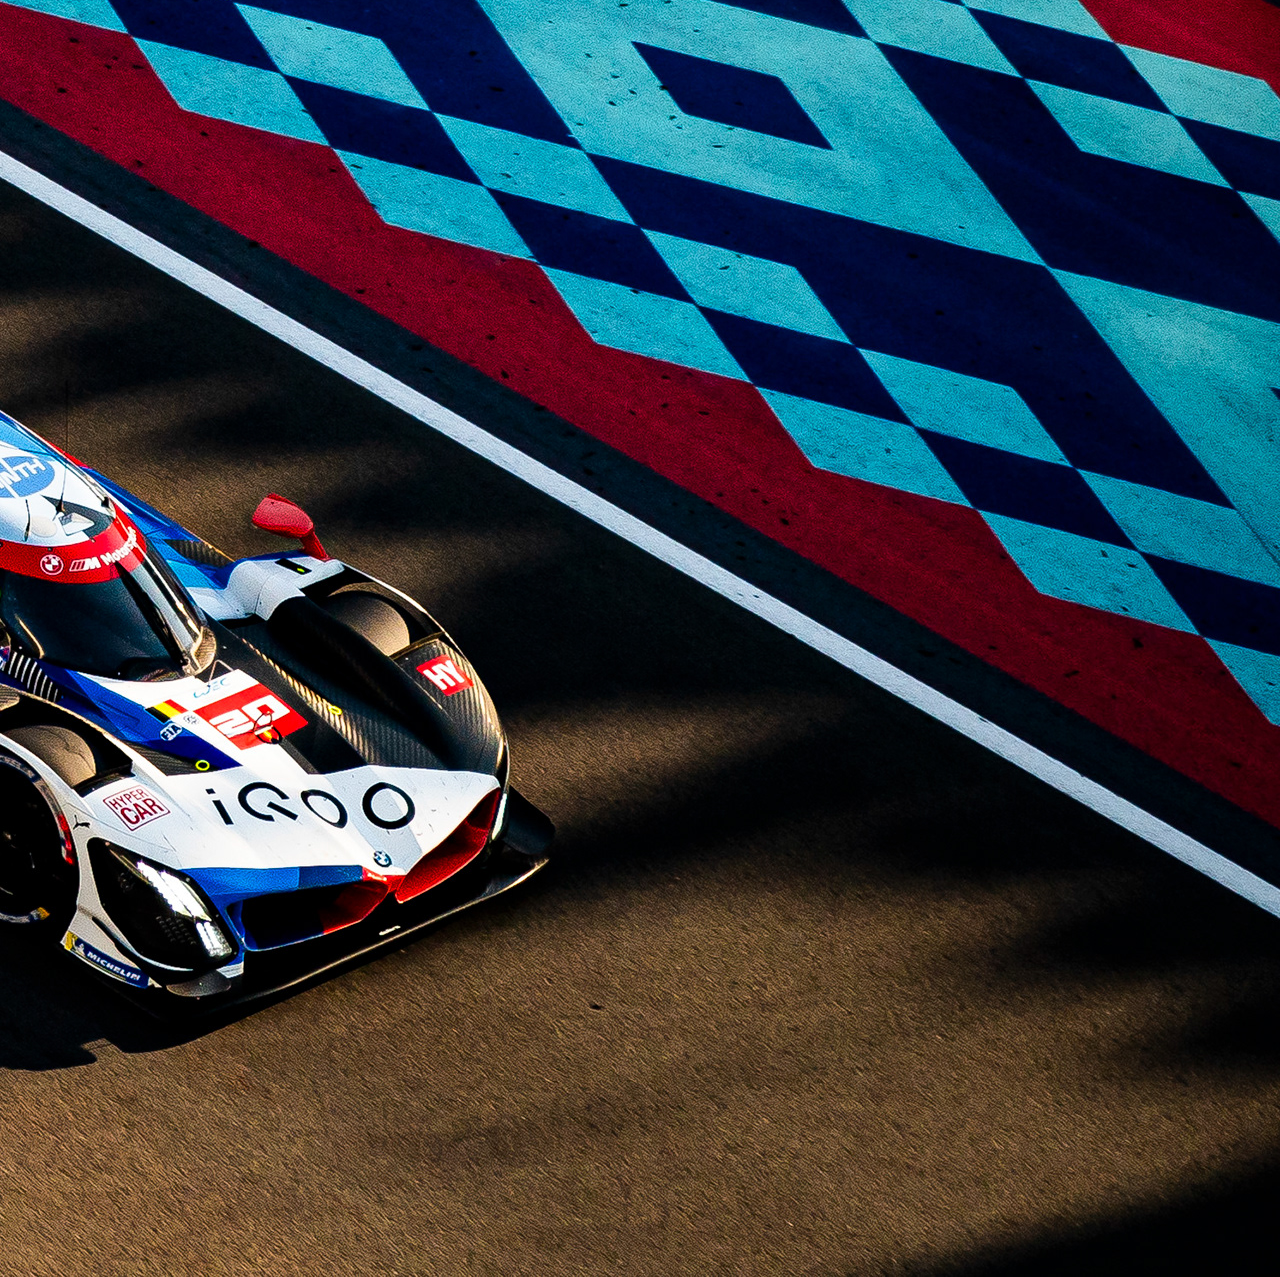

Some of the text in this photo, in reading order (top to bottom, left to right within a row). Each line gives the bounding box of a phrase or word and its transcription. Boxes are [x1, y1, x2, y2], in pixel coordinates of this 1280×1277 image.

[423, 660, 465, 691] HY
[209, 694, 291, 739] 20
[161, 724, 182, 741] FIA
[108, 788, 149, 811] HYPER
[120, 798, 165, 825] CAR
[205, 781, 416, 831] iQOO
[86, 951, 141, 981] MICHELIN
